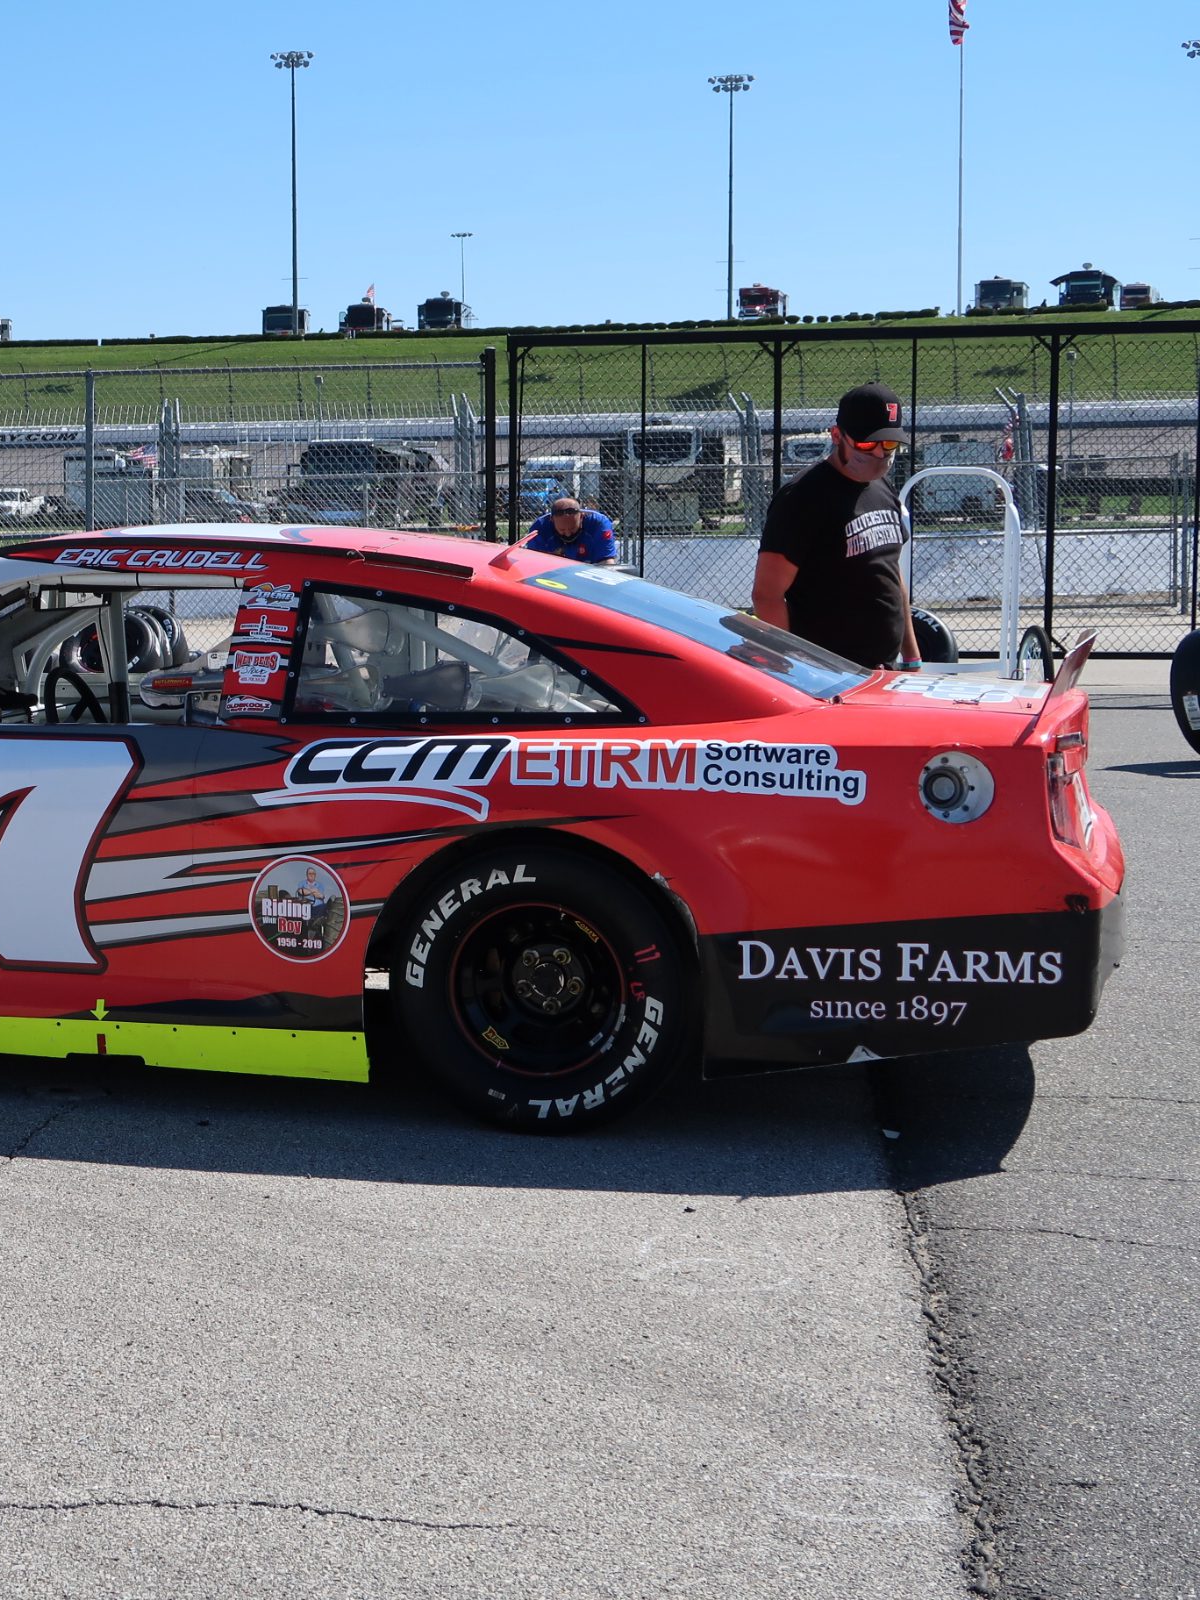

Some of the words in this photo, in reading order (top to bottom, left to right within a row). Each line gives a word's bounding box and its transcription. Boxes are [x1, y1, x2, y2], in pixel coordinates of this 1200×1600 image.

[845, 509, 895, 537] UNIVERSITY
[54, 548, 129, 568] ERIC
[127, 549, 269, 571] CAUDELL
[515, 742, 697, 784] ETRM
[704, 742, 831, 766] Software
[702, 764, 860, 799] Consulting
[262, 898, 311, 920] Riding
[278, 917, 302, 934] Roy
[405, 864, 536, 988] GENERAL
[277, 937, 297, 948] 1956
[302, 938, 322, 949] 2019
[738, 940, 881, 981] DAVIS
[896, 943, 1062, 984] FARMS
[810, 998, 887, 1019] since
[896, 995, 968, 1026] 1897
[528, 996, 664, 1119] GENERAL
